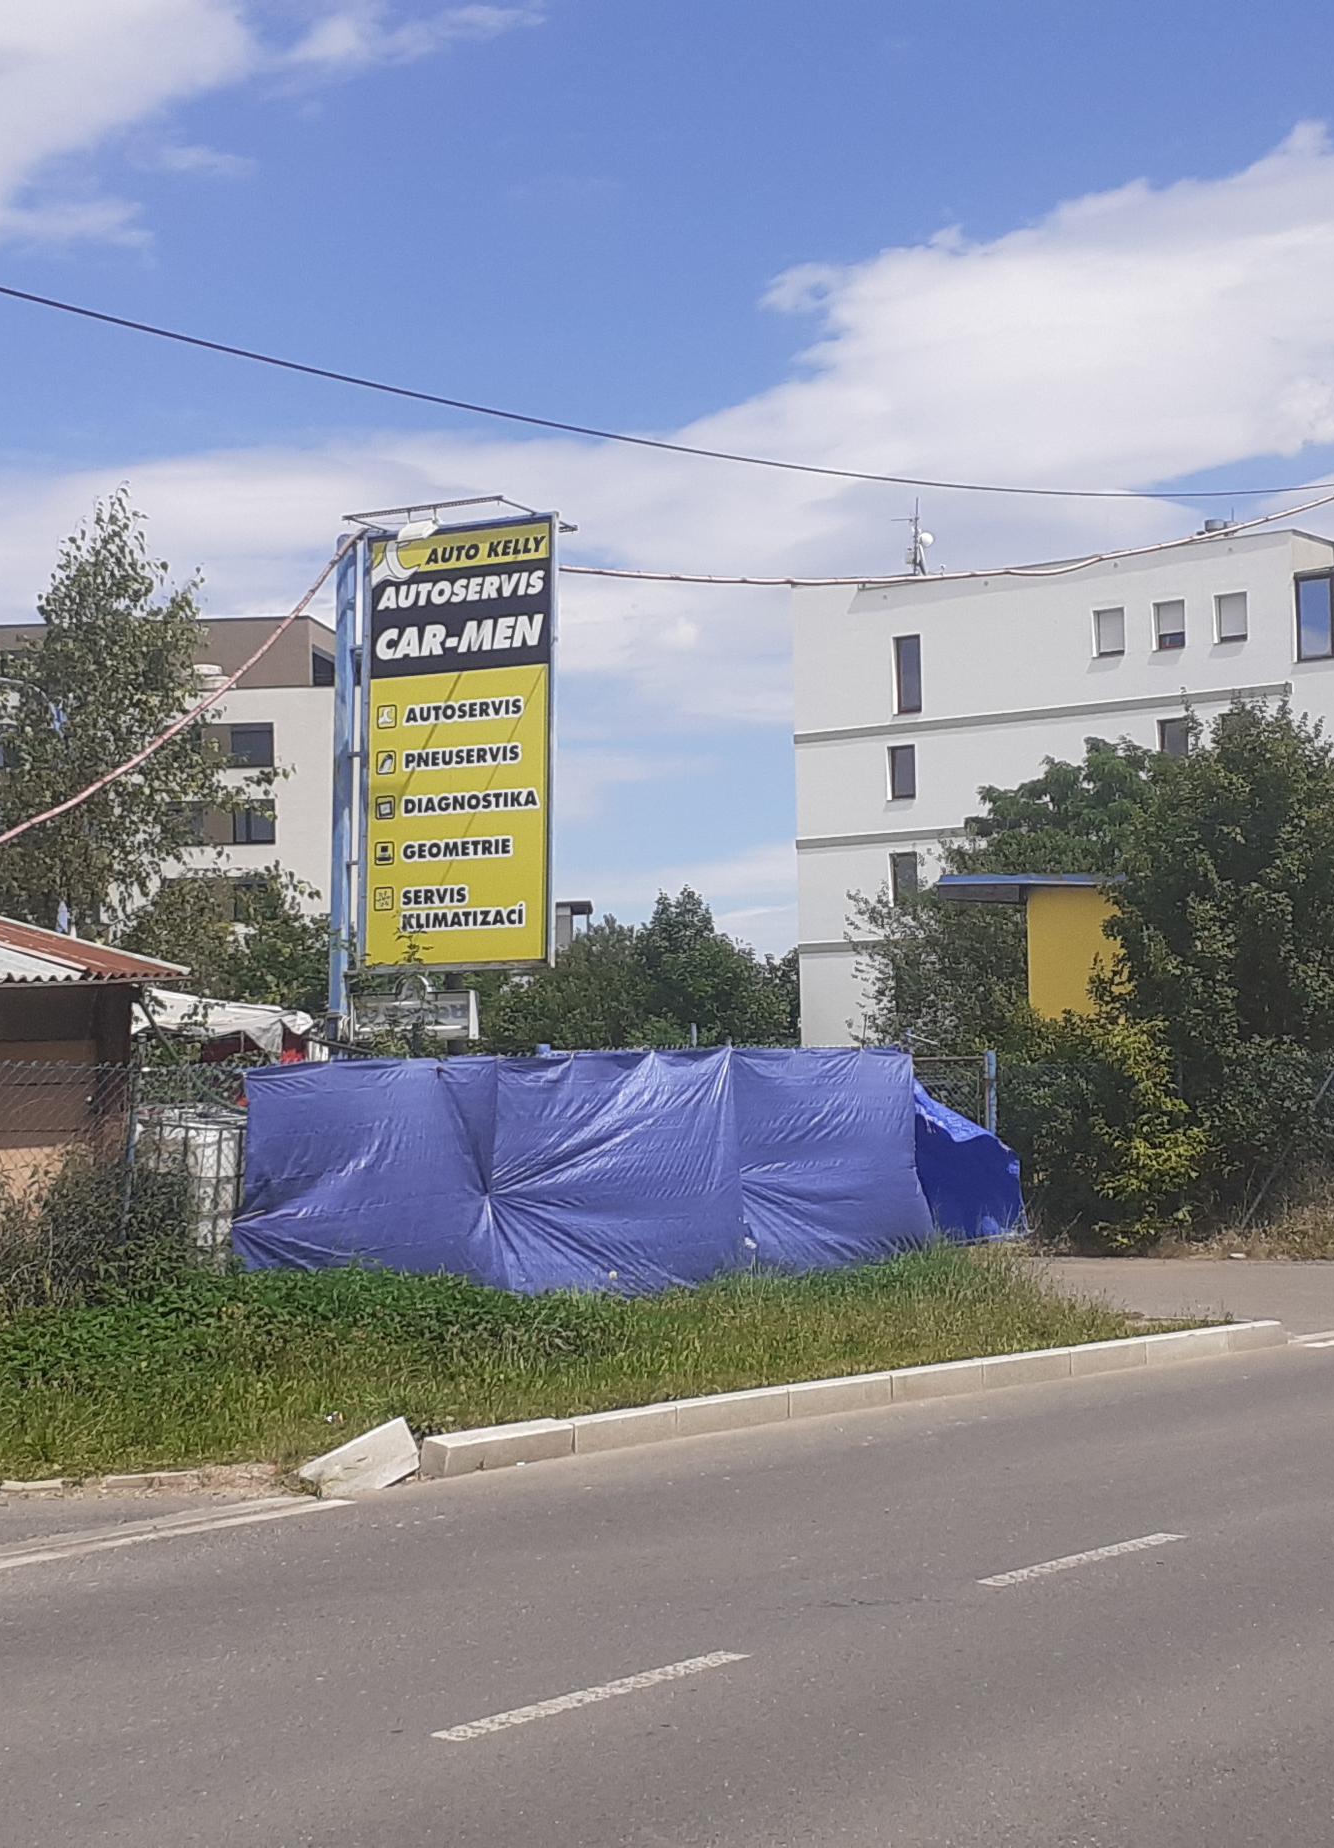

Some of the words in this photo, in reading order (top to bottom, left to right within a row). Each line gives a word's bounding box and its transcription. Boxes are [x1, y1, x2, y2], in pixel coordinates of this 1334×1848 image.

[425, 544, 480, 566] AUTO
[487, 535, 546, 559] KELLY
[376, 570, 545, 611] AUTOSERVIS
[375, 613, 545, 661] CAR-MEN
[405, 698, 523, 724] AUTOSERVIS
[404, 744, 520, 769] PNEUSERVIS
[403, 790, 538, 814] DIAGNOSTIKA
[402, 838, 511, 860] GEOMETRIE
[402, 887, 467, 906] SERVIS
[401, 903, 524, 930] KLIMATIZACÍ
